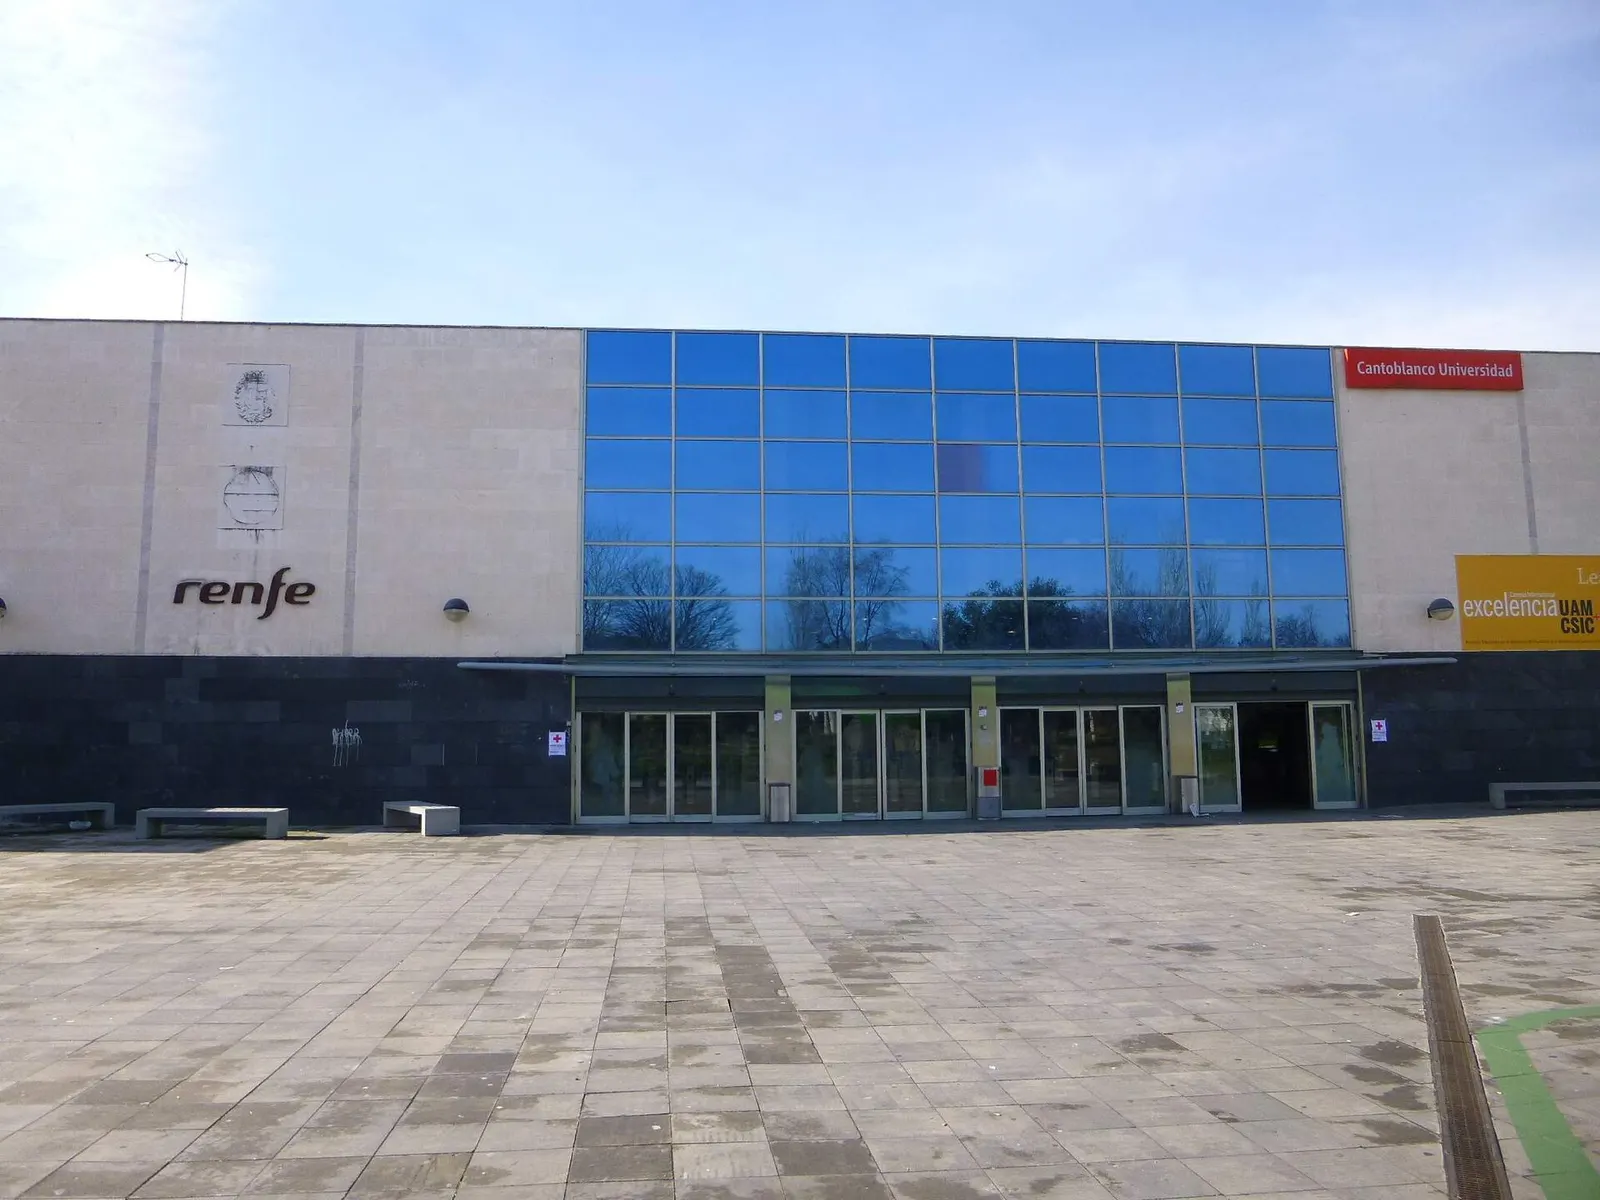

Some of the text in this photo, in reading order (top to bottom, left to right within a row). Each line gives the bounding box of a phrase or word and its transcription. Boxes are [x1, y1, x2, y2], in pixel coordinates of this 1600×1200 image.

[1357, 361, 1513, 378] Cantoblanco Universidad
[1576, 567, 1600, 585] Le
[172, 566, 316, 620] renfe
[1463, 591, 1593, 617] excelencia UAM
[1560, 617, 1595, 634] CSIC
